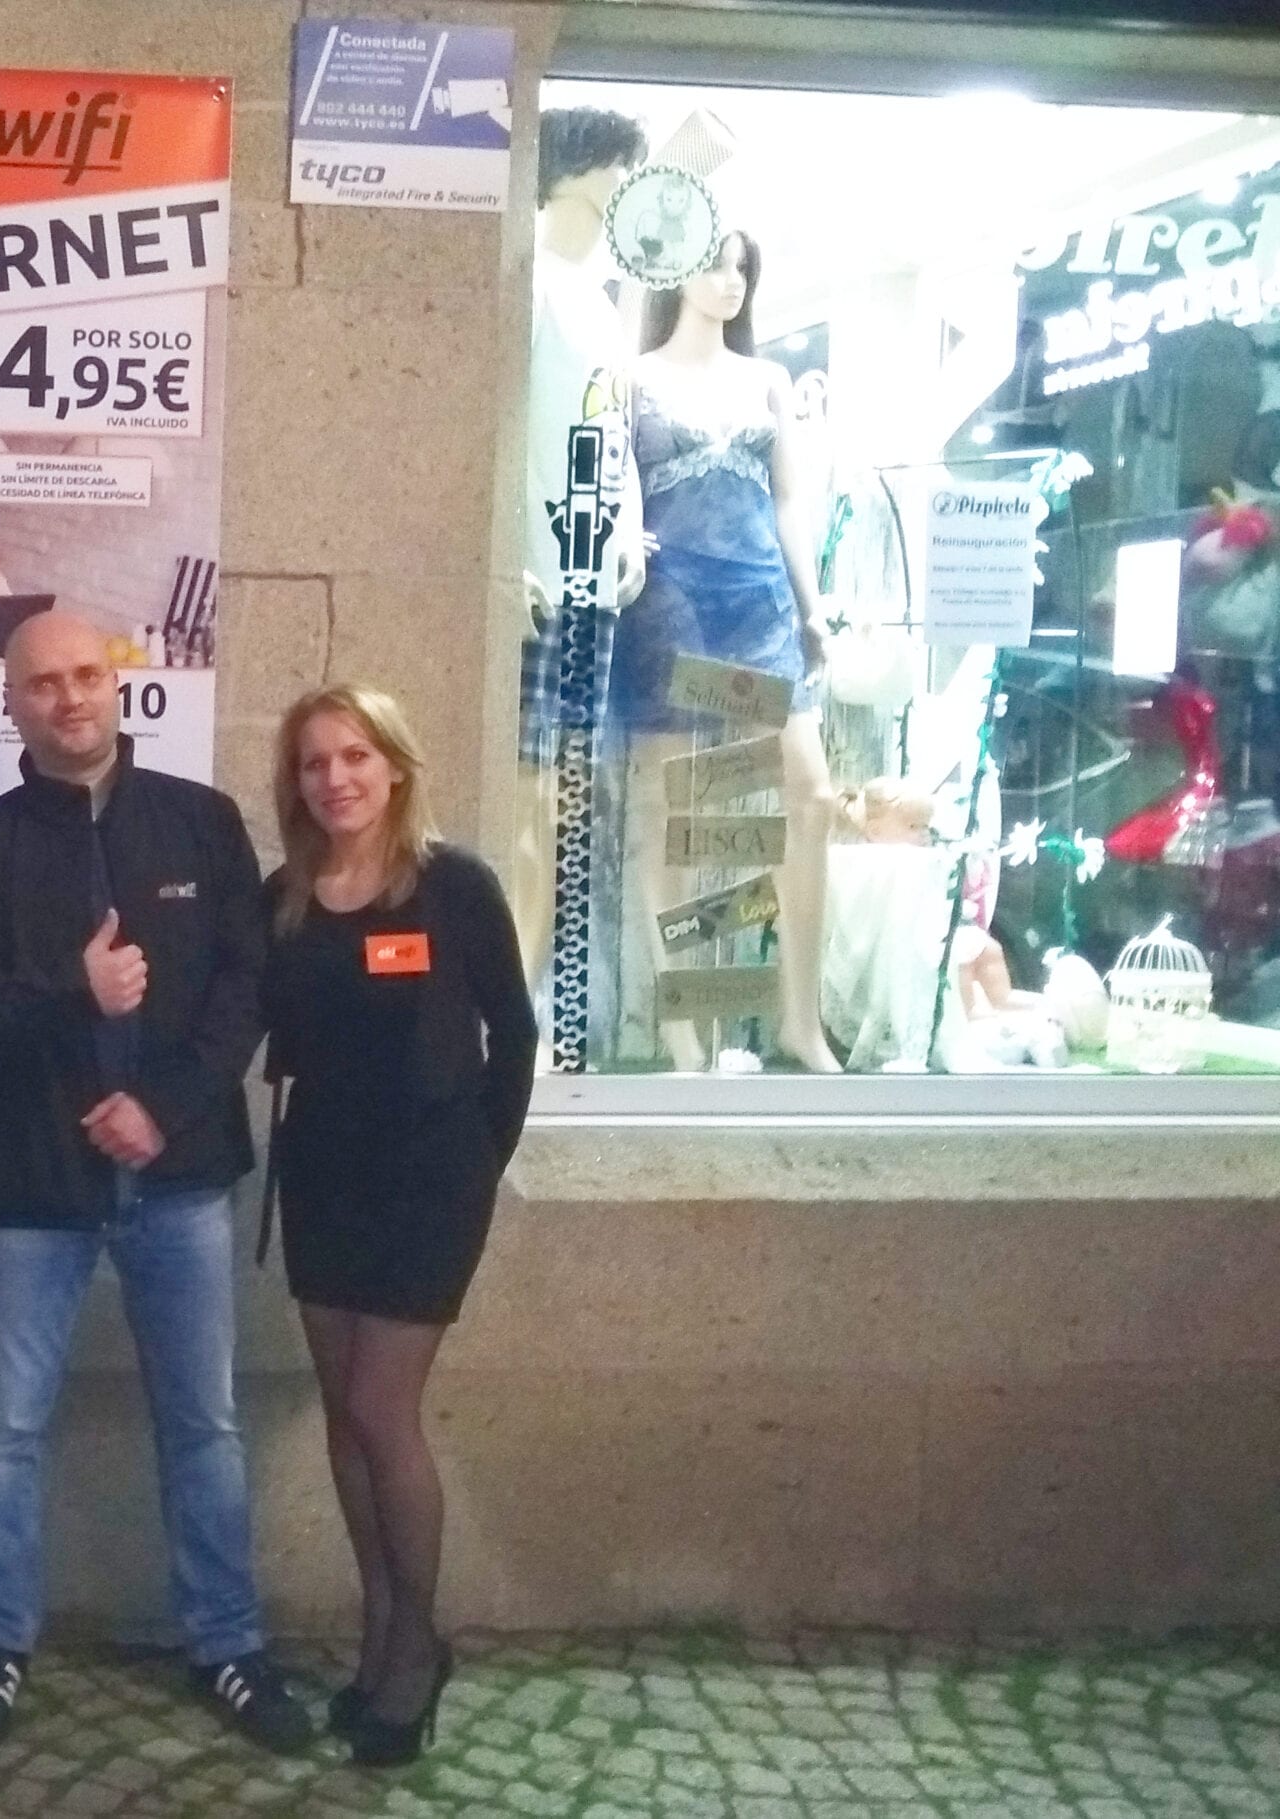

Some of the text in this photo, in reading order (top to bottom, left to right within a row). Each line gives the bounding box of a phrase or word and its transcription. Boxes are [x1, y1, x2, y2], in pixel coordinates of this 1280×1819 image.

[340, 32, 426, 51] Conectada
[299, 158, 386, 188] tyco
[407, 189, 431, 200] Fire
[433, 191, 444, 202] &
[447, 192, 500, 206] Security
[73, 329, 192, 350] POR SOLO
[106, 417, 189, 429] IVA INCLUIDO
[16, 462, 103, 472] SIN PERMANENCIA
[1, 475, 16, 484] SIN
[51, 476, 63, 485] DE
[66, 477, 118, 486] DESCARGA
[43, 490, 55, 498] DE
[118, 682, 167, 720] 10
